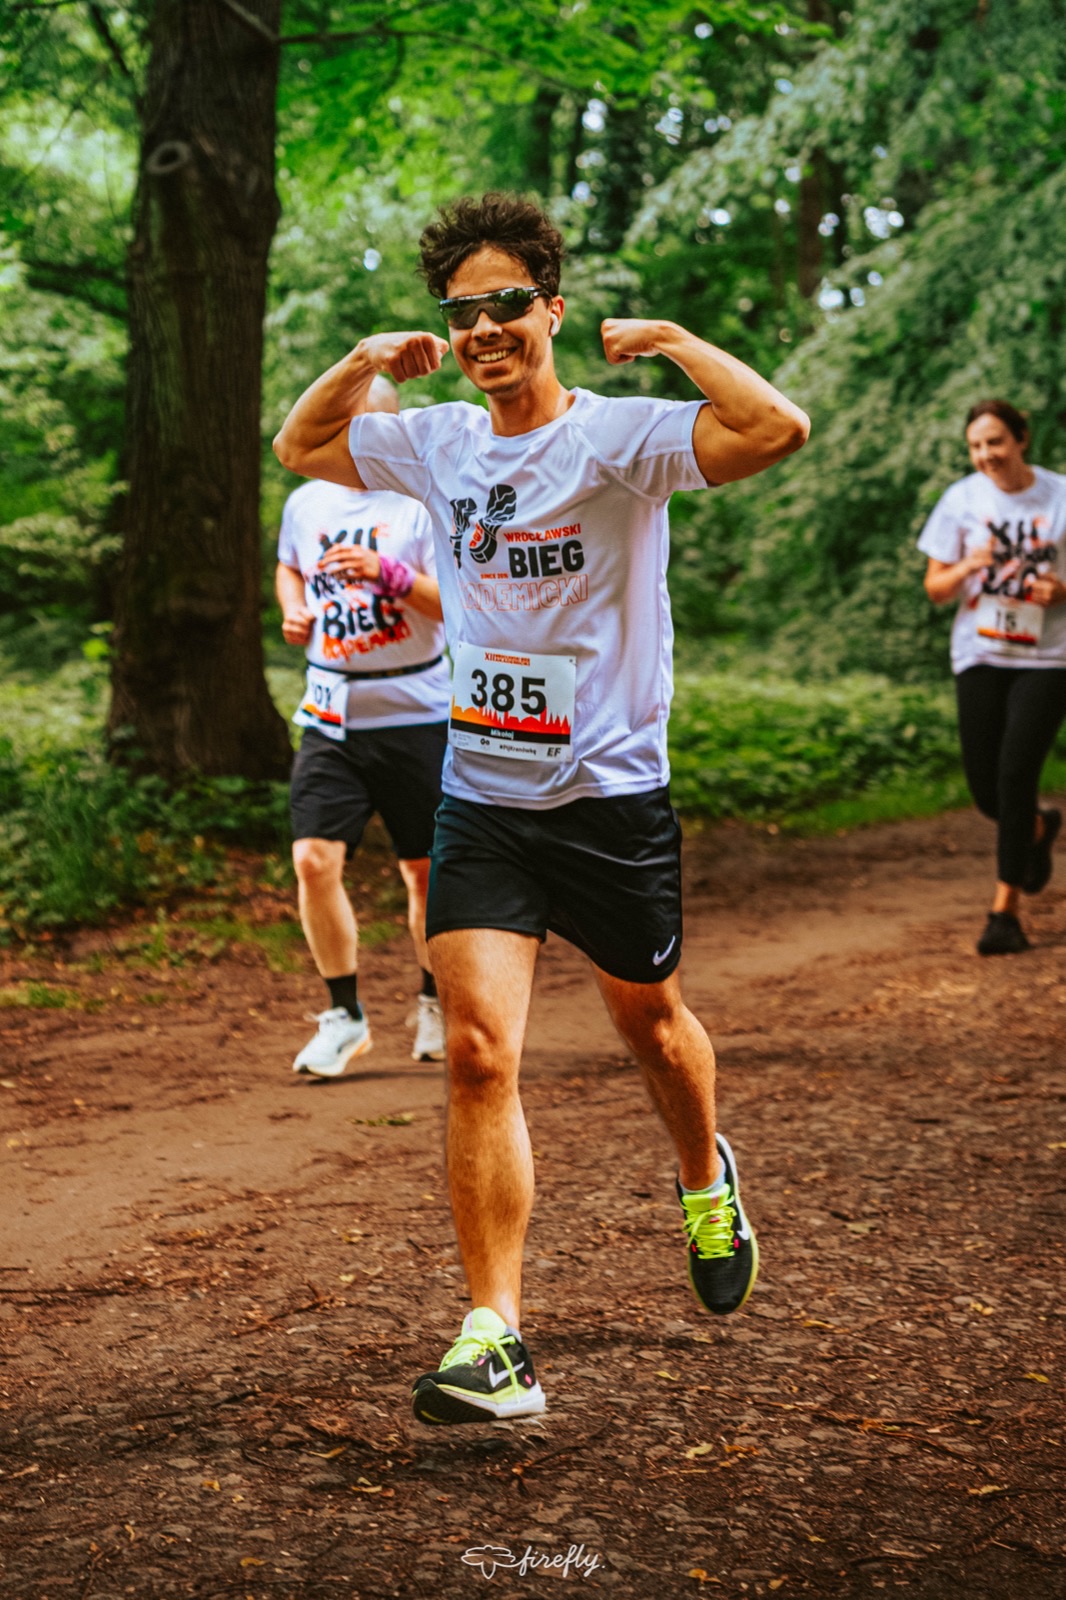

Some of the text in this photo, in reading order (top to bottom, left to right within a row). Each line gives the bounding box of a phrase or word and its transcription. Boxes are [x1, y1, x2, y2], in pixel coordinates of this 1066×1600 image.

[503, 523, 582, 543] WROCŁAWSKI
[508, 539, 585, 579] BIEG
[470, 668, 547, 716] 385
[546, 747, 562, 758] EF
